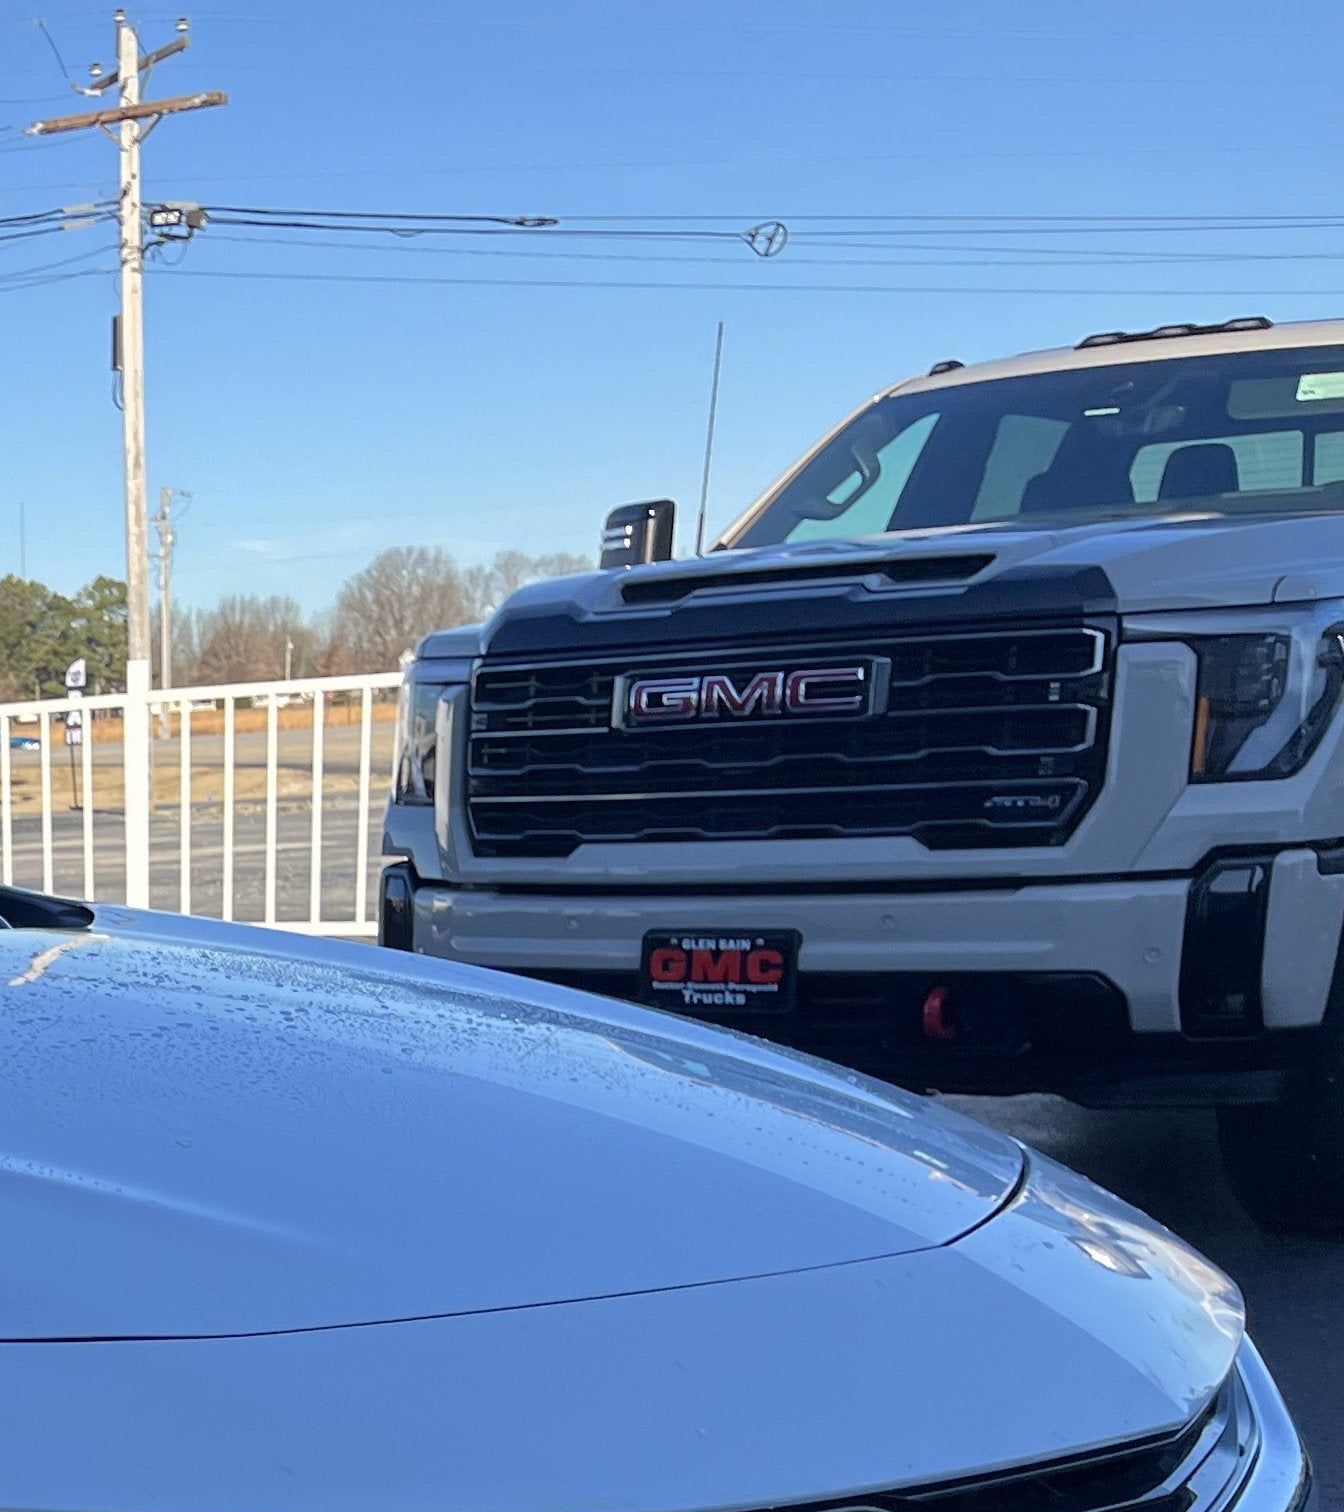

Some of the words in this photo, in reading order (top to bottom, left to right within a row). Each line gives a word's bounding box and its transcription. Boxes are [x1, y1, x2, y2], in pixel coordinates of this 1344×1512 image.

[629, 667, 865, 721] GMC
[650, 948, 783, 983] GMC
[682, 989, 746, 1005] Trucks
